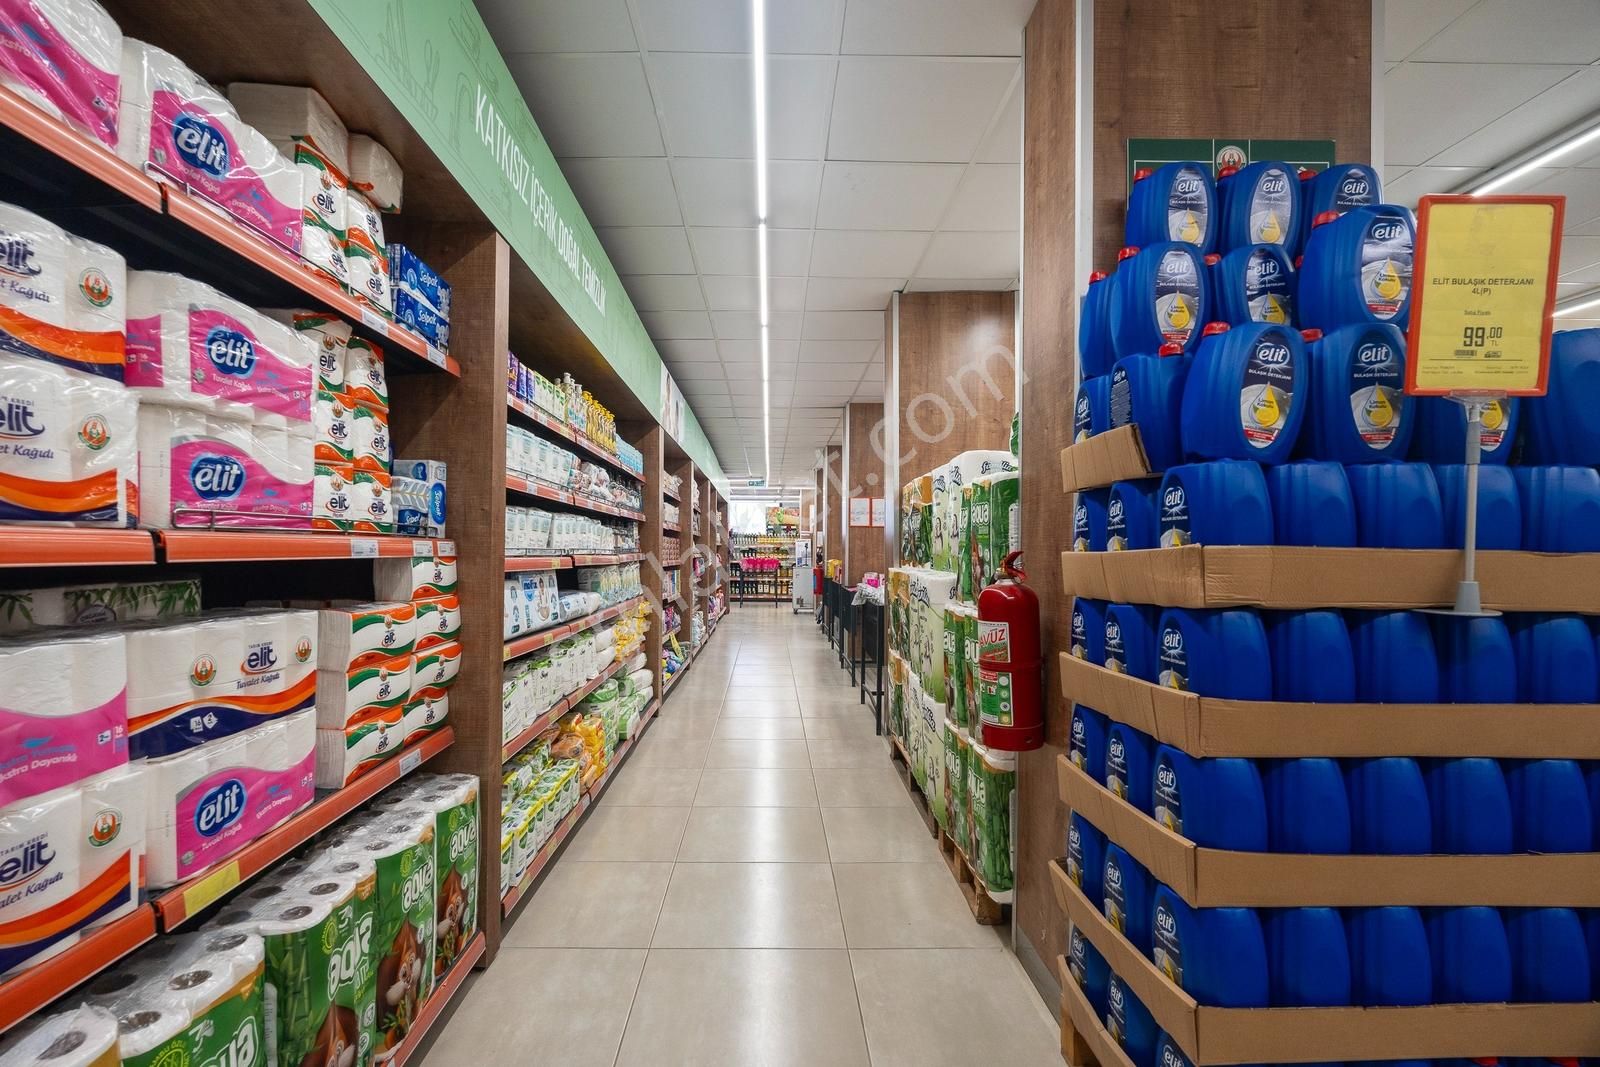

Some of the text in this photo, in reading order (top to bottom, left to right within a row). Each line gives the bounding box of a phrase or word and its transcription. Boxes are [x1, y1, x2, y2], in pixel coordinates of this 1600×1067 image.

[177, 127, 227, 171] elit
[1178, 180, 1198, 193] elit
[1263, 180, 1284, 193] elit
[1344, 182, 1365, 194] elit
[317, 192, 336, 214] elit
[475, 83, 607, 318] KATKISIZ İÇERİK DOĞAL TEMİZLİK
[1374, 223, 1402, 239] elit
[1166, 260, 1188, 274] elit
[1255, 260, 1275, 275] elit
[369, 276, 384, 295] elit
[419, 270, 438, 287] Selpak
[1432, 276, 1534, 287] ELİT BULAŞIK DETERJANI
[1471, 287, 1492, 296] 4L(P)
[417, 308, 436, 326] Selpak
[210, 338, 250, 370] elit
[1258, 346, 1286, 362] elit
[1361, 346, 1387, 362] elit
[320, 354, 336, 372] elit
[1078, 398, 1088, 414] elit
[332, 422, 348, 439] elit
[14, 445, 54, 459] Kağıdı
[374, 437, 387, 451] elit
[195, 462, 241, 492] elit
[329, 493, 350, 513] elit
[434, 489, 442, 517] Selpak
[1166, 488, 1183, 507] elit
[371, 500, 388, 516] elit
[1076, 507, 1086, 521] elit
[1110, 502, 1121, 517] elit
[1073, 616, 1083, 627] elit
[1106, 627, 1118, 639] elit
[1164, 633, 1180, 648] elit
[247, 646, 278, 669] elit
[236, 677, 260, 691] Tuvalet
[1073, 721, 1083, 733] elit
[1110, 743, 1123, 757] elit
[1158, 769, 1175, 786] elit
[199, 783, 240, 832] elit
[1069, 828, 1079, 842] elit
[0, 840, 56, 883] elit
[1107, 866, 1119, 883] elit
[26, 871, 64, 897] Kağıdı
[1157, 911, 1174, 932] elit
[1111, 984, 1122, 1004] elit
